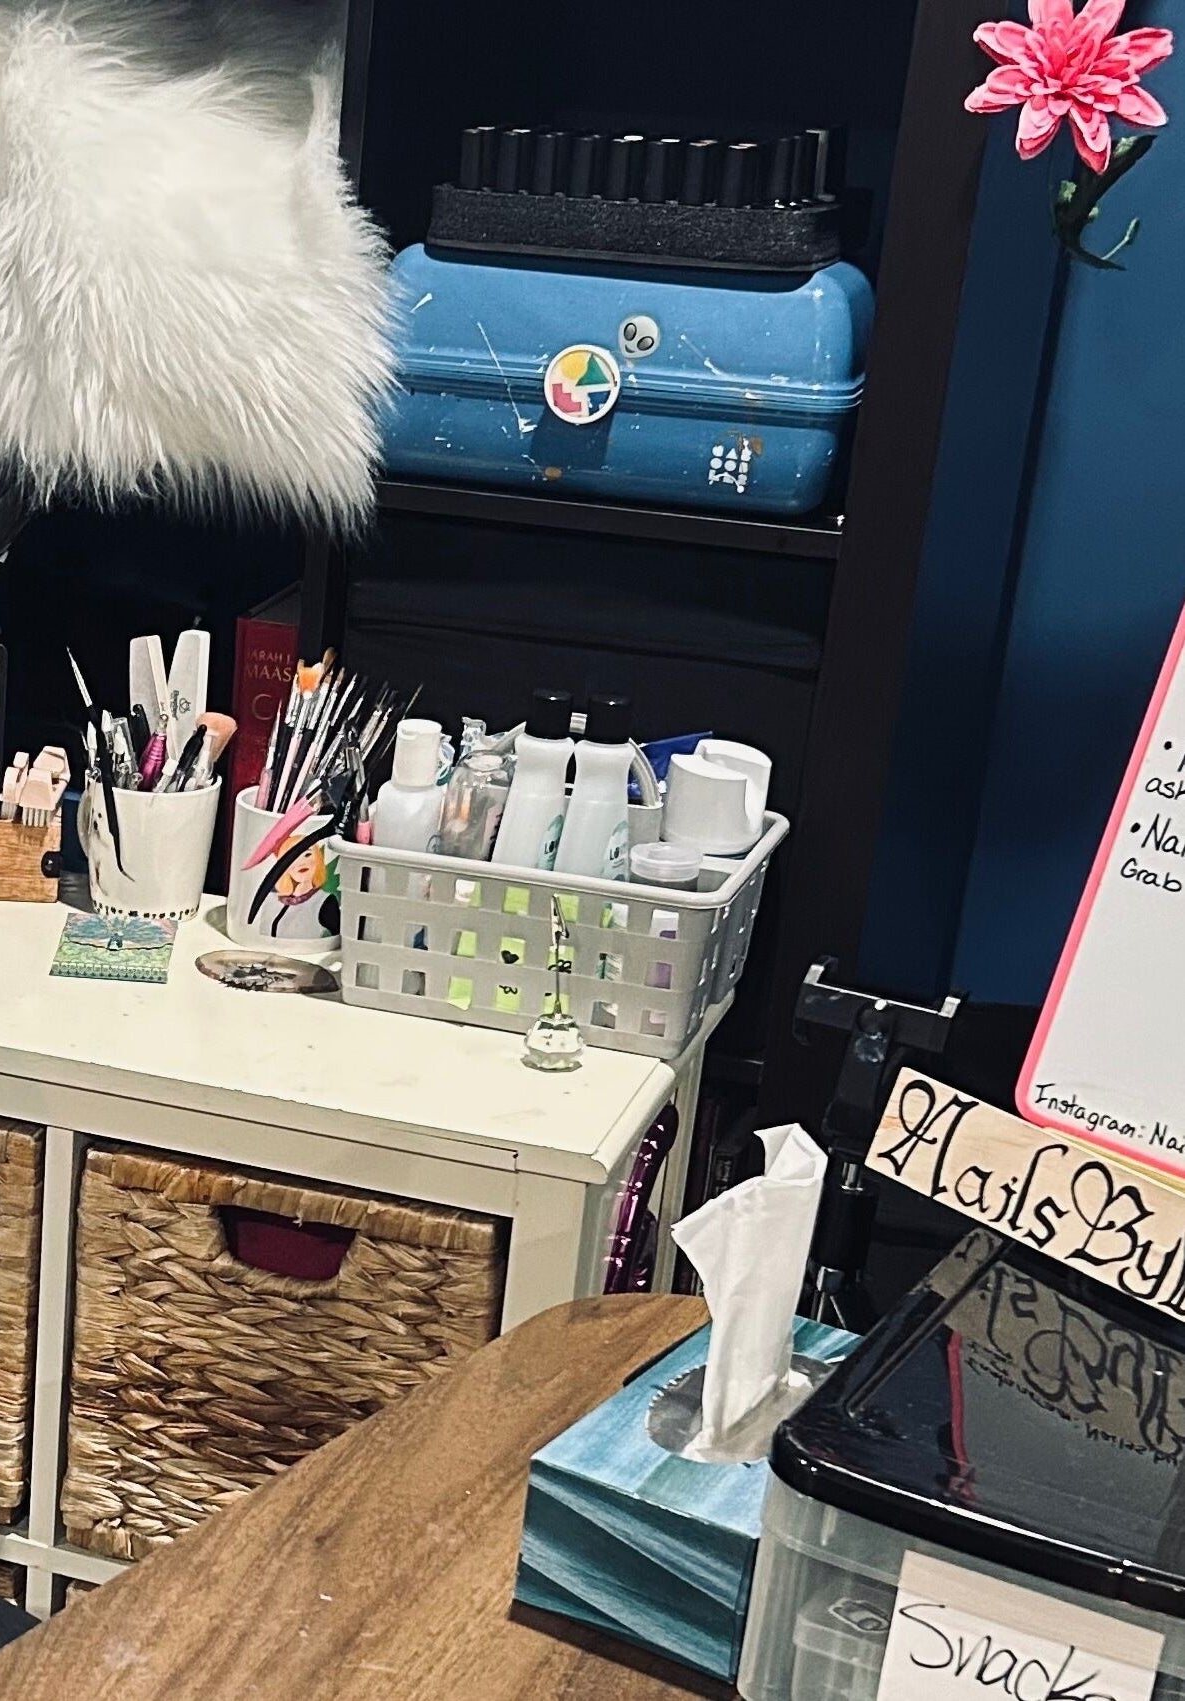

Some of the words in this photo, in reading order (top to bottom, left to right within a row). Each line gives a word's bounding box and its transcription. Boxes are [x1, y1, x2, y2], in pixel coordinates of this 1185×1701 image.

[244, 663, 292, 682] MAAS
[1120, 857, 1182, 892] Grab
[877, 1080, 1070, 1248] Nails
